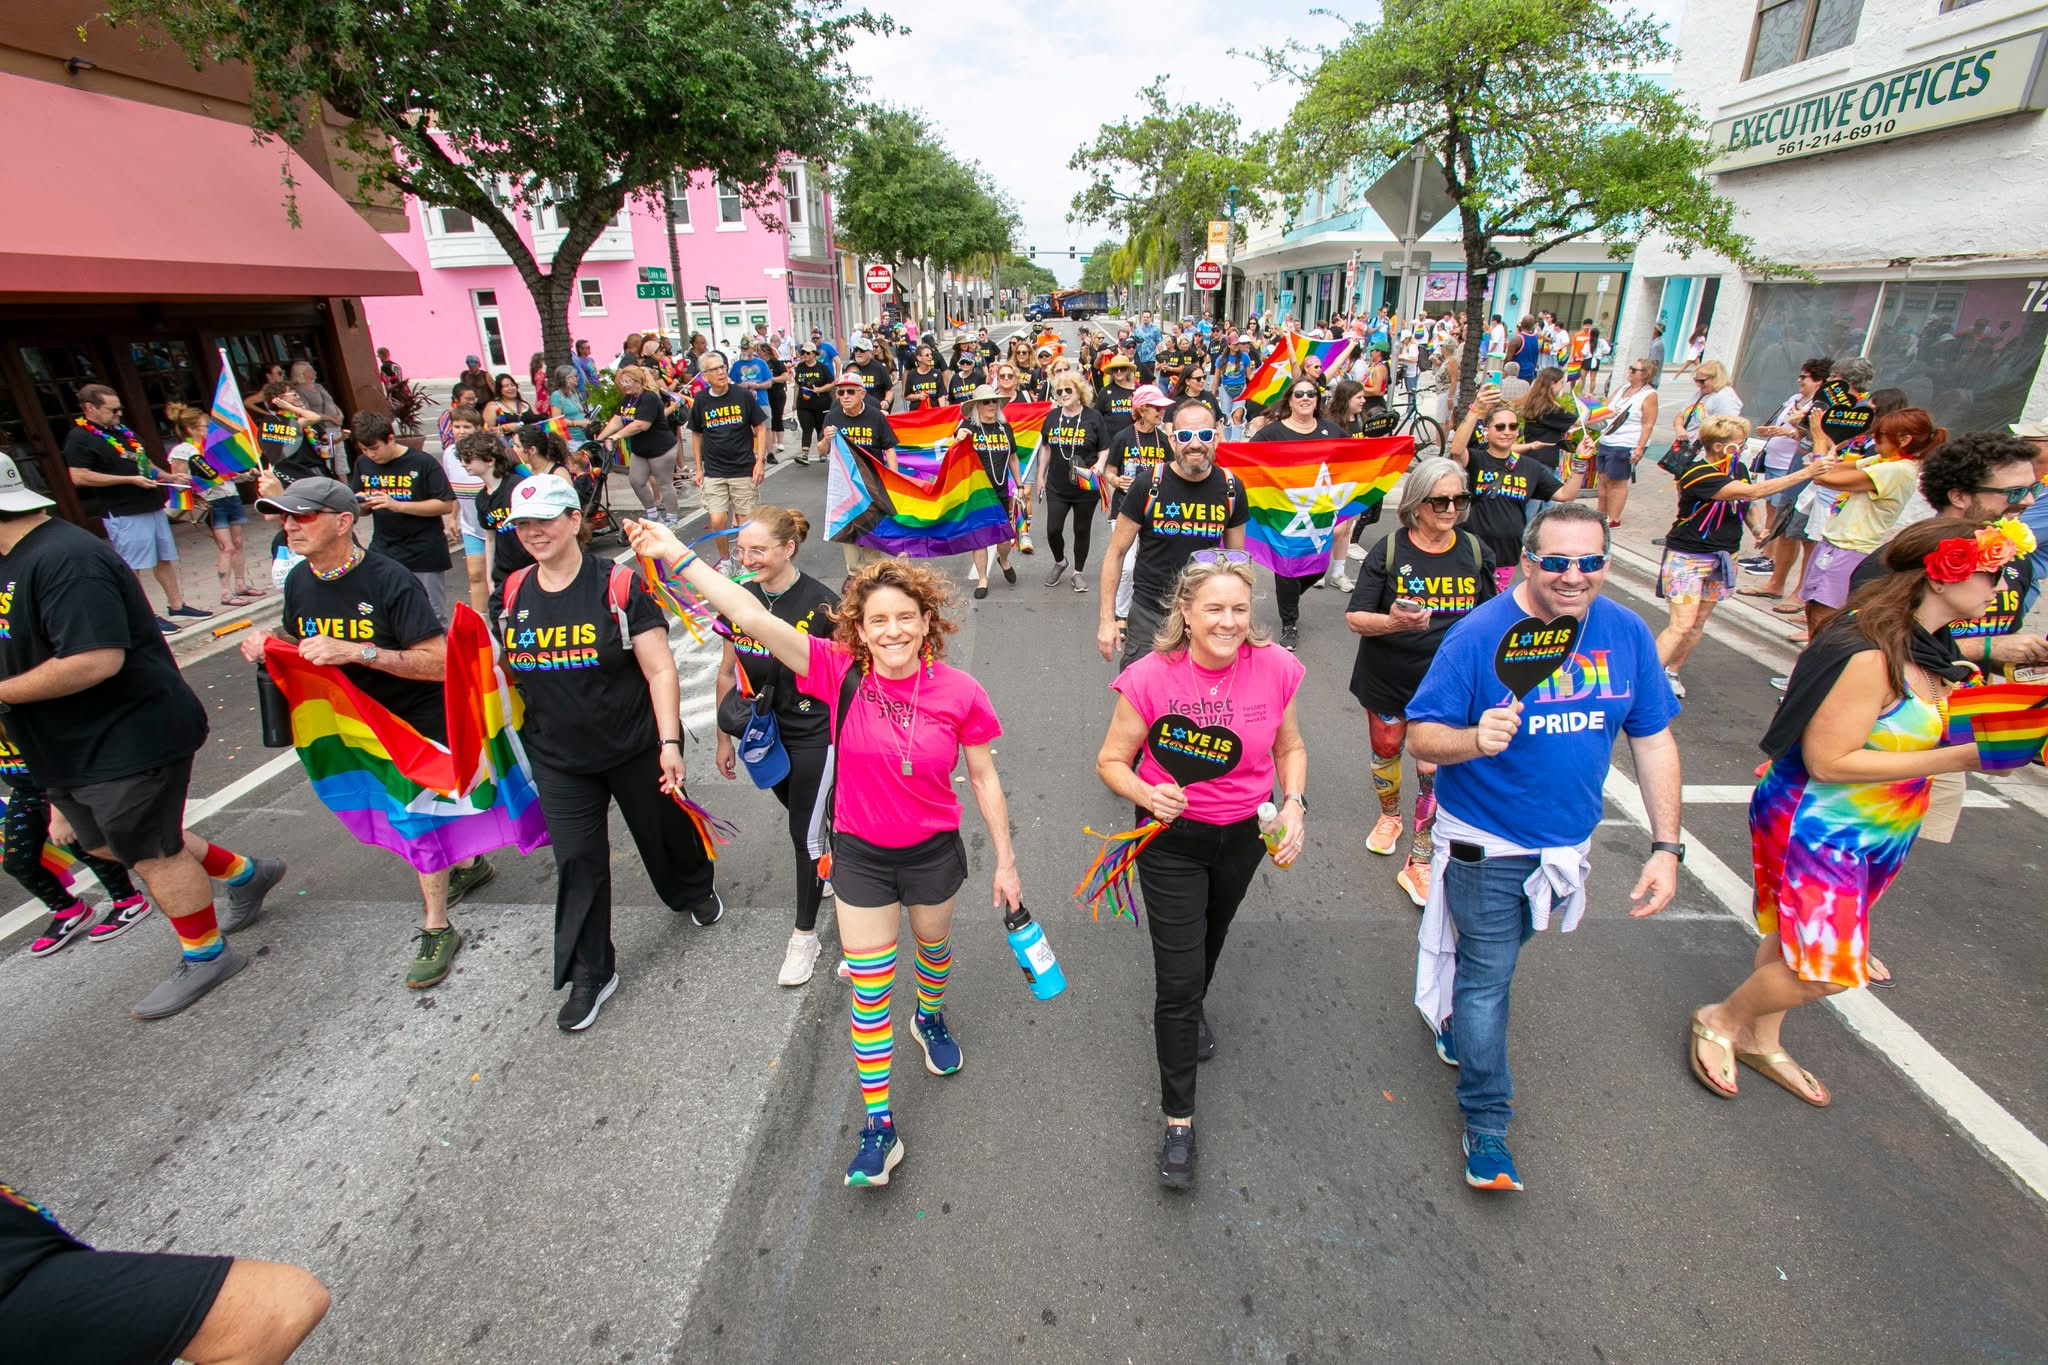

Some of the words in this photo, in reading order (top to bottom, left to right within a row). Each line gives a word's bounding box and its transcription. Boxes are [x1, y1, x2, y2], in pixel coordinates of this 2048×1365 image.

[1729, 88, 1858, 147] EXECUTIVE
[1859, 50, 1997, 121] OFFICES
[1776, 119, 1896, 156] 561-214-6910
[640, 287, 645, 296] S
[650, 287, 655, 296] J
[660, 286, 670, 296] St
[731, 405, 741, 415] IS
[1858, 412, 1870, 420] IS
[286, 425, 297, 436] IS
[863, 427, 872, 436] IS
[398, 475, 412, 487] IS
[1514, 476, 1527, 488] IS
[1153, 502, 1206, 520] LOVE
[1210, 504, 1226, 521] IS
[1152, 520, 1225, 538] KOSHER
[1397, 577, 1453, 595] LOVE
[1458, 577, 1475, 594] IS
[2003, 590, 2019, 611] IS
[350, 619, 374, 639] IS
[506, 625, 567, 649] LOVE
[573, 623, 596, 645] IS
[1509, 630, 1553, 648] LOVE
[1554, 629, 1571, 644] IS
[1168, 697, 1233, 715] Keshet
[1528, 711, 1605, 735] PRIDE
[1161, 723, 1212, 748] LOVE
[1213, 738, 1233, 753] IS
